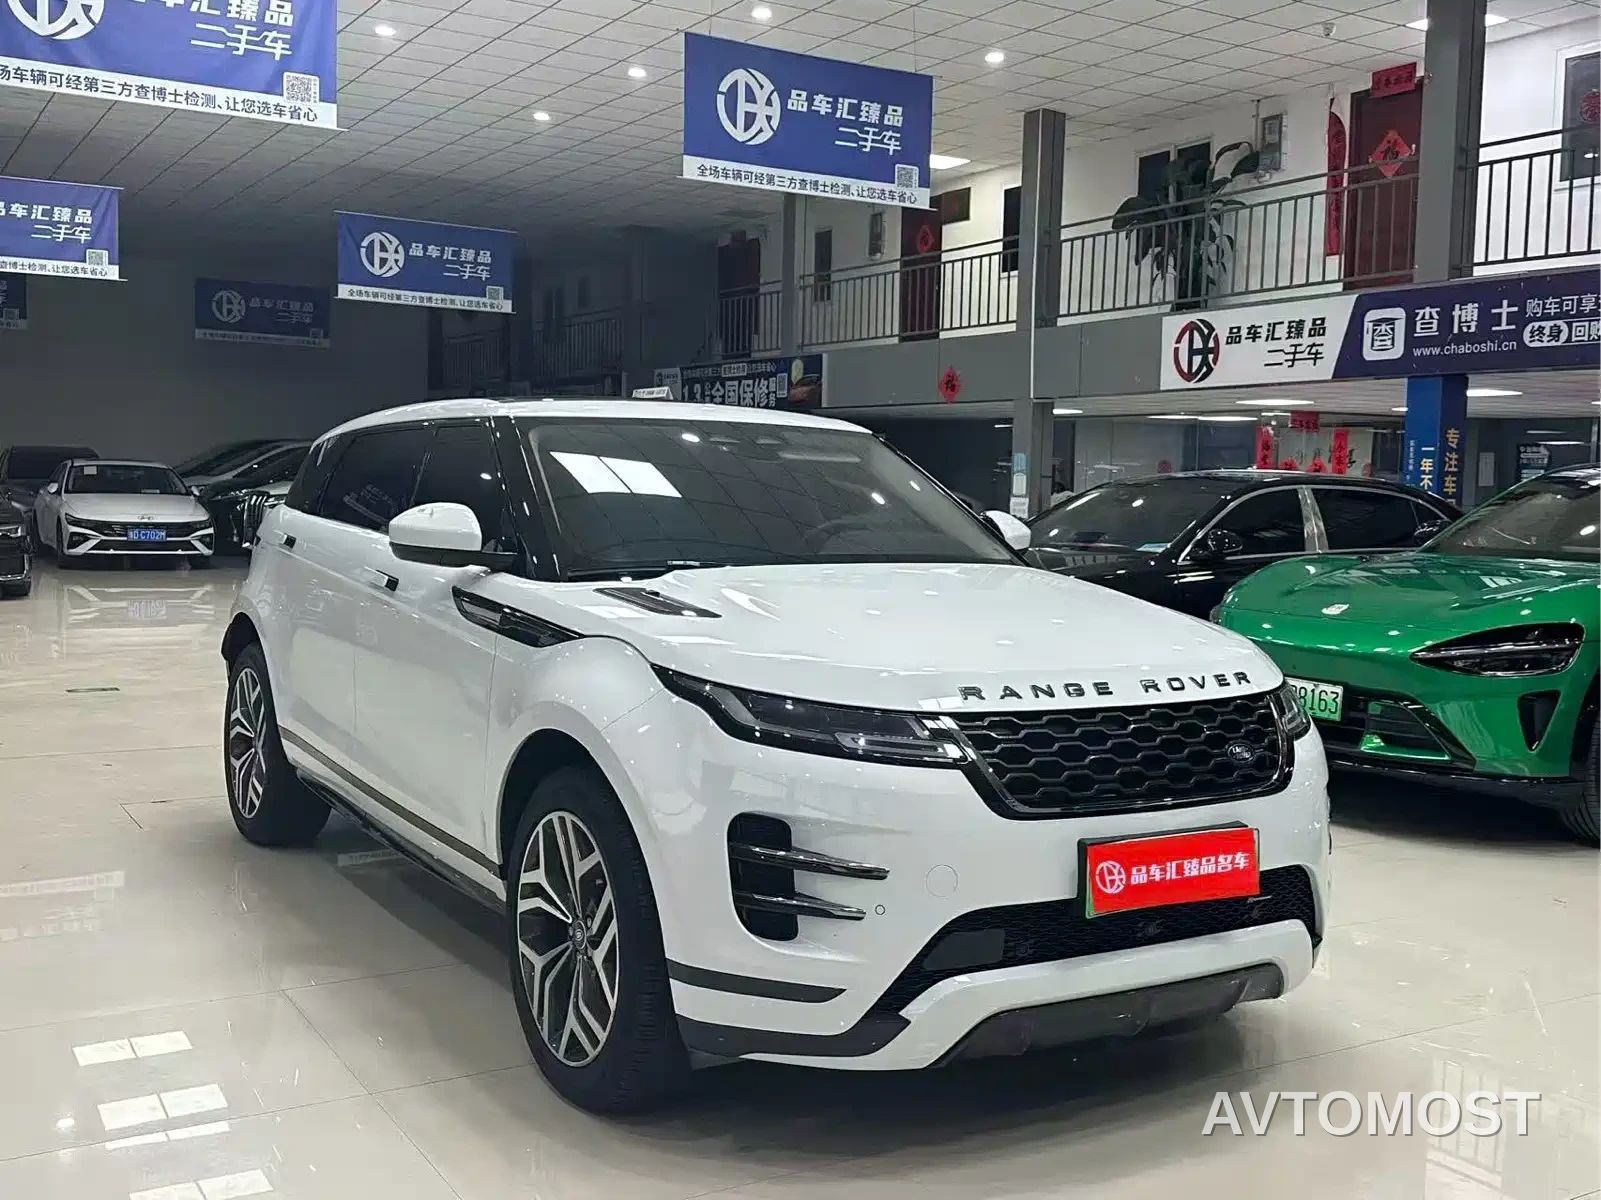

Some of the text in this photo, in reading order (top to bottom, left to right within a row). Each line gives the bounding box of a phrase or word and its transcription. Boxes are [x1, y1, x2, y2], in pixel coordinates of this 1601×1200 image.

[190, 24, 292, 61] 二手车
[787, 89, 903, 127] 品车汇臻品
[835, 126, 901, 155] 二手车
[697, 163, 917, 204] 全场车辆可经第三方查博士检测、让您选车省心
[31, 224, 92, 244] 二手车
[409, 243, 491, 264] 品车汇臻品
[443, 264, 491, 281] 二手车
[1413, 299, 1518, 338] 查博士
[1525, 293, 1601, 318] 购车可享
[1225, 316, 1327, 346] 品车汇臻品
[1528, 323, 1564, 344] 终身
[1263, 342, 1325, 368] 二手车
[1413, 339, 1517, 357] www.chaboshi.cn
[957, 671, 1252, 701] RANGE ROVER
[1130, 851, 1250, 886] 品车汇臻品名车
